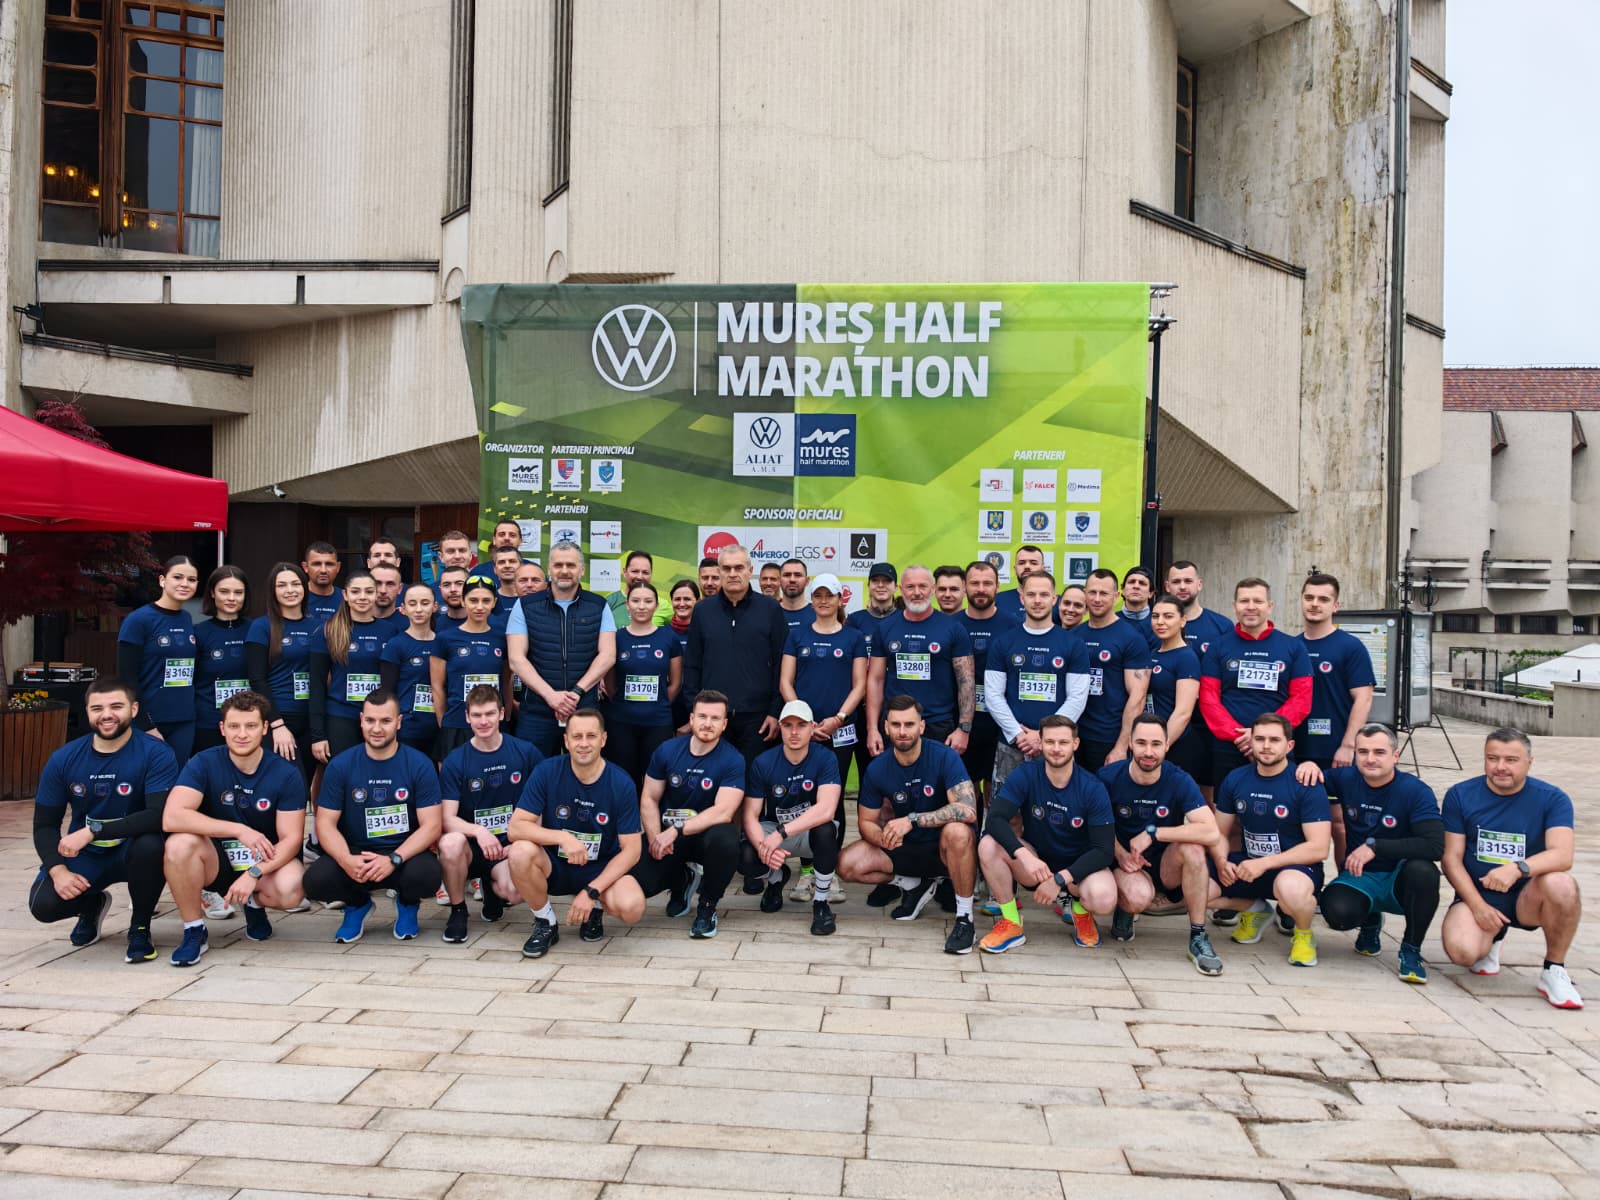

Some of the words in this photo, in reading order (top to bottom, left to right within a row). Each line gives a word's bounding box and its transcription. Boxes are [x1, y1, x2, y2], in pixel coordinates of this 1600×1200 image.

[884, 302, 1002, 344] HALF
[718, 356, 989, 398] MARATHON
[485, 443, 545, 454] ORGANIZATOR
[552, 445, 592, 454] PARTENERI
[592, 446, 635, 456] PRINCIPALI
[800, 446, 850, 458] mures
[745, 455, 784, 464] ALIAT
[1013, 450, 1066, 460] PARTENERI
[544, 504, 589, 514] PARTENERI
[744, 508, 796, 520] SPONSORI
[798, 508, 844, 520] OFICIALI
[795, 546, 821, 559] EGS
[902, 662, 924, 671] 3280
[1246, 670, 1270, 681] 2173
[301, 681, 310, 690] 31
[631, 684, 652, 692] 3170
[1026, 682, 1049, 692] 3137
[374, 816, 400, 827] 3143
[484, 816, 506, 827] 3158
[1248, 842, 1273, 852] 2169
[1486, 842, 1516, 854] 3153
[229, 850, 252, 860] 315
